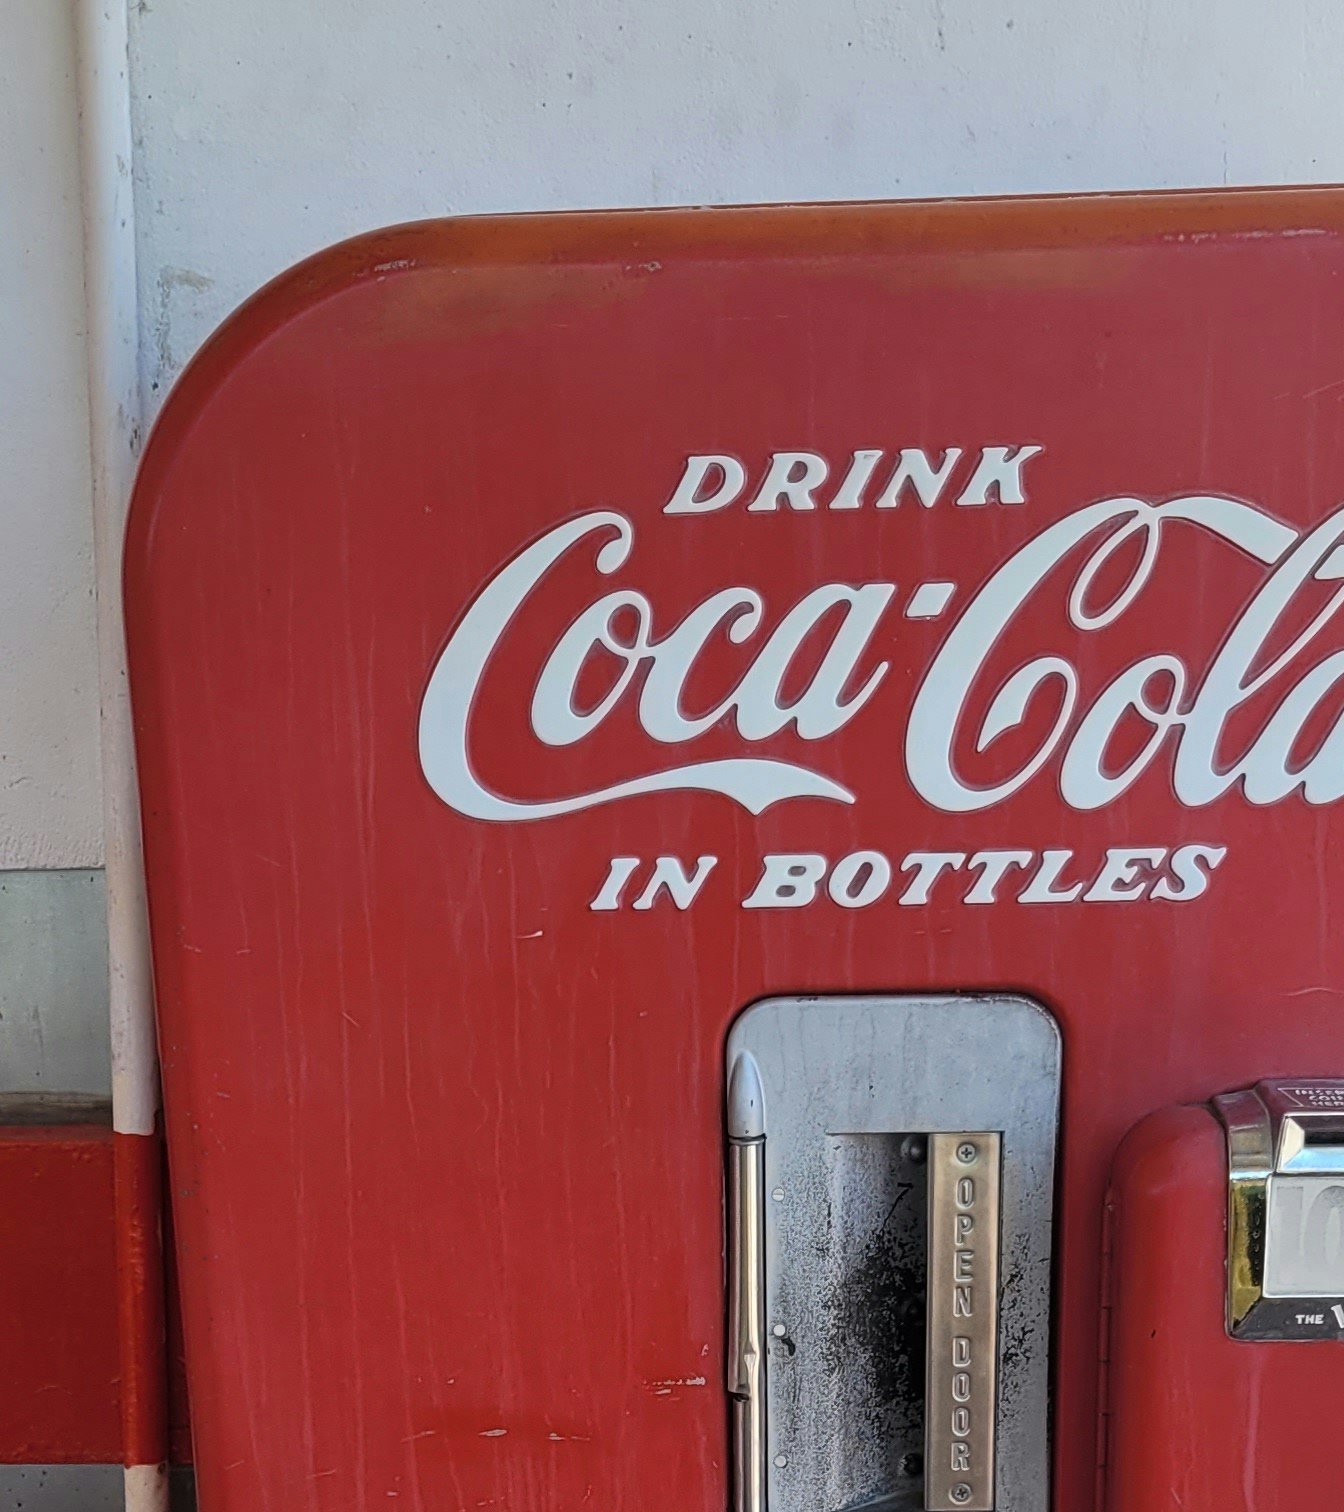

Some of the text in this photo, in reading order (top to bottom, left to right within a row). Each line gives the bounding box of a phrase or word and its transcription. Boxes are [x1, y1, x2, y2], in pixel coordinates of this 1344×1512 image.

[664, 445, 1043, 514] DRINK
[590, 845, 1228, 911] IN BOTTLES
[952, 1177, 975, 1318] OPEN
[1295, 1314, 1324, 1325] THE
[950, 1337, 974, 1471] DOOR
